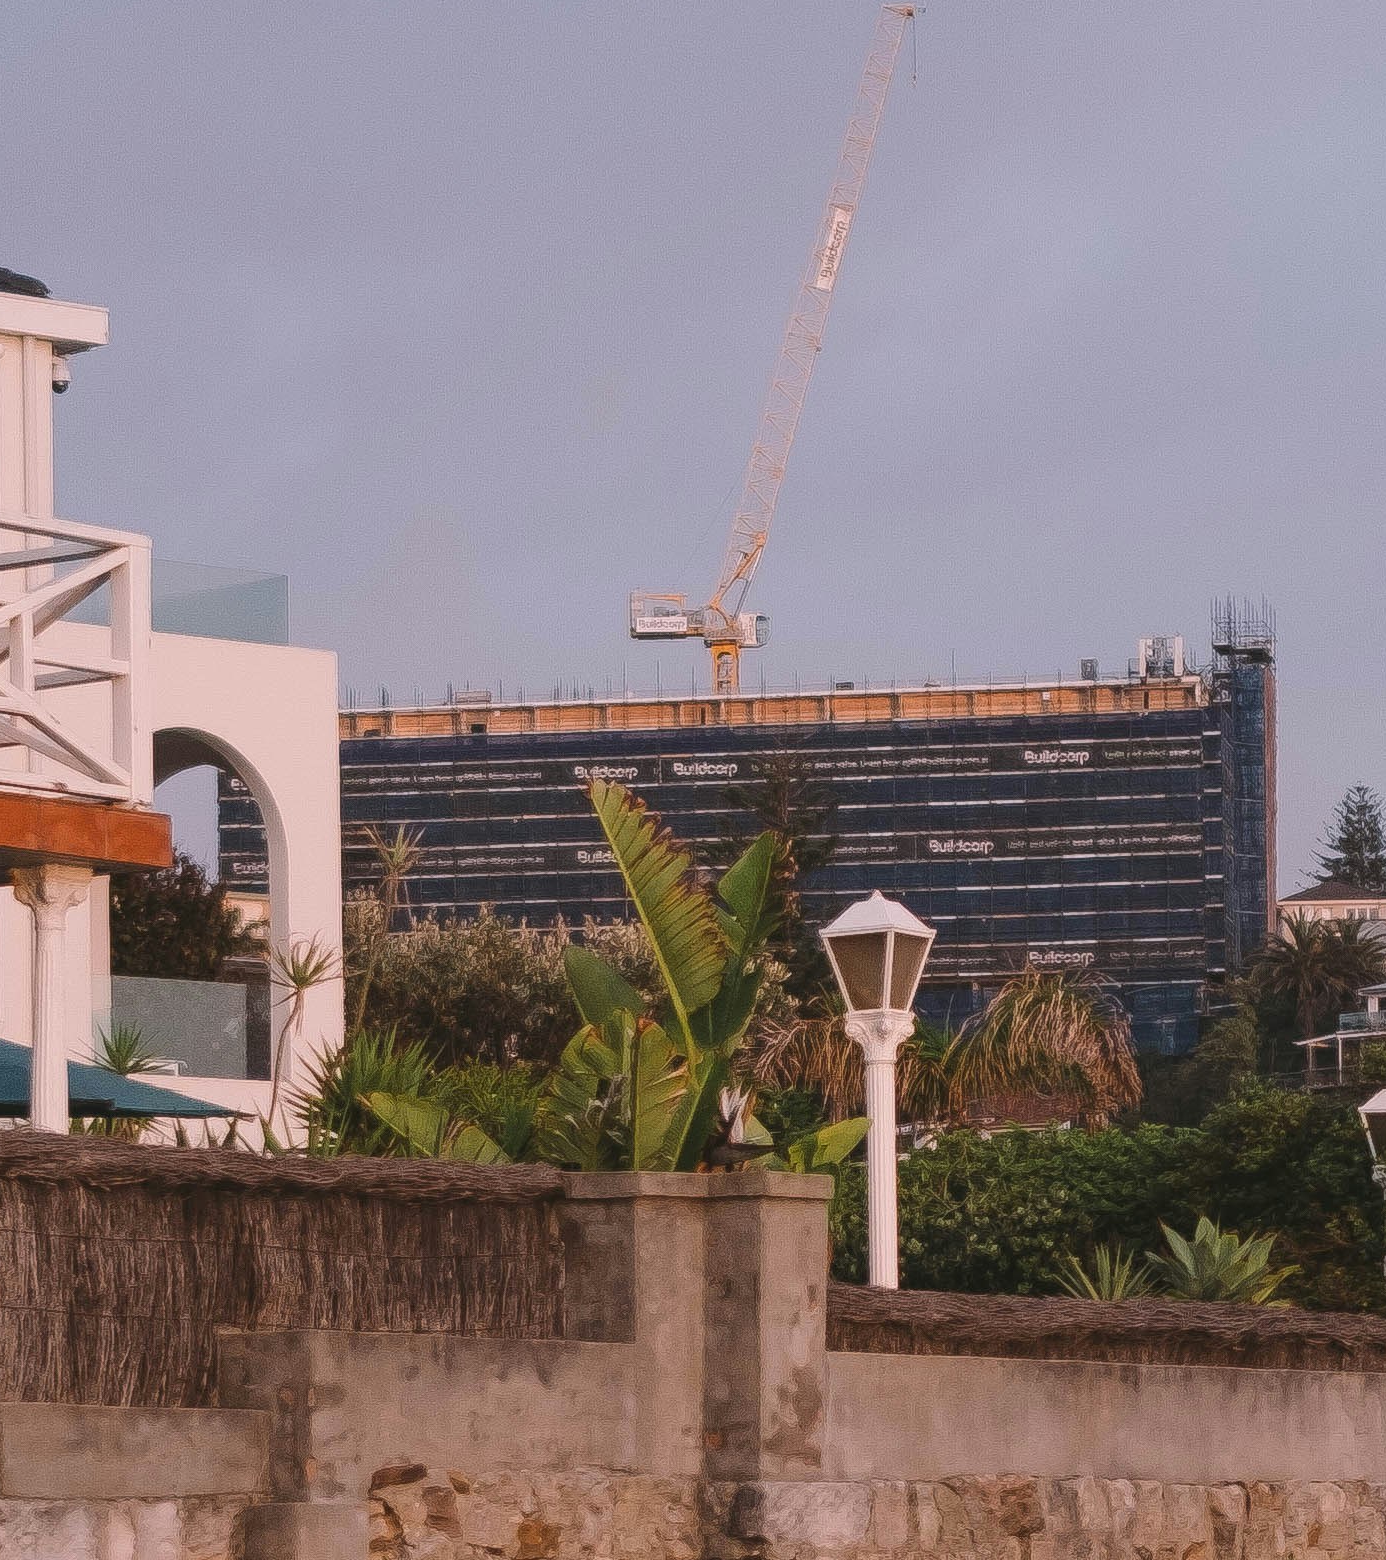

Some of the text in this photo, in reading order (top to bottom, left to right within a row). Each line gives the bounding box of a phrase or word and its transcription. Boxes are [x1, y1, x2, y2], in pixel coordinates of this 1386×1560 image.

[820, 221, 849, 278] Buildcorp
[638, 619, 685, 630] Buildcorp
[1024, 750, 1090, 765] Buildcorp
[574, 766, 639, 779] Buildcorp
[673, 763, 738, 777] Buildcorp
[928, 840, 995, 855] Buildcorp
[1029, 951, 1096, 967] Buildcorp
